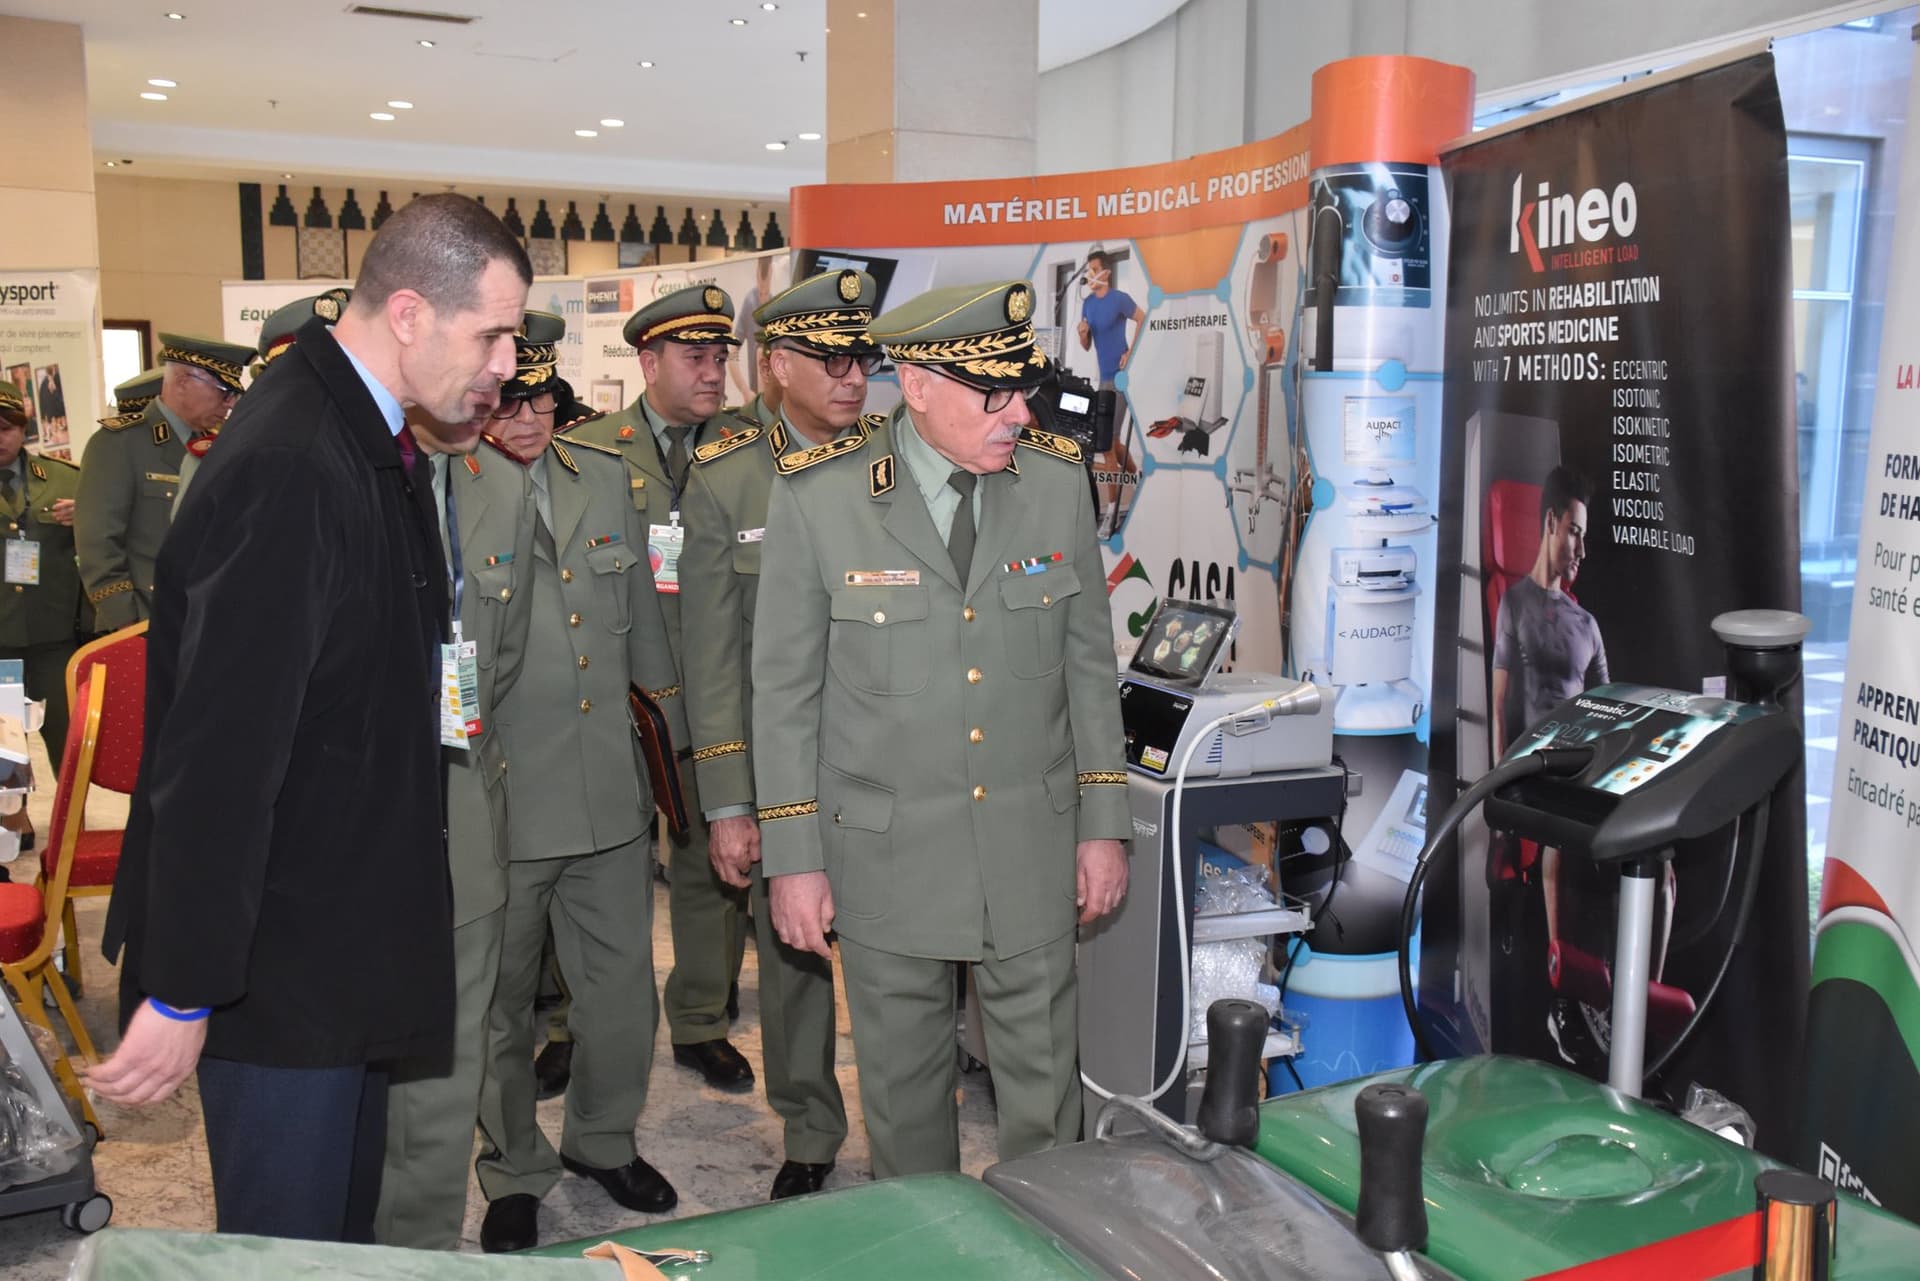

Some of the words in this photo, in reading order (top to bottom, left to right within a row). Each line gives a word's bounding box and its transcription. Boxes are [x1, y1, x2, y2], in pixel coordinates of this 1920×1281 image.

[943, 196, 1087, 225] MATÉRIEL
[1096, 181, 1200, 217] MÉDICAL
[1207, 151, 1310, 201] PROFESSION
[1510, 172, 1638, 273] kineo
[1551, 247, 1615, 271] INTELLIGENT
[1617, 244, 1639, 262] LOAD
[1475, 296, 1492, 318] NO
[1493, 290, 1529, 315] LIMITS
[1532, 288, 1546, 312] IN
[1549, 276, 1661, 310] REHABILITATION
[1474, 326, 1496, 348] AND
[1498, 322, 1546, 347] SPORTS
[1548, 316, 1619, 344] MEDICINE
[1473, 360, 1499, 382] WITH
[1503, 356, 1512, 381] 7
[1518, 352, 1606, 381] METHODS:
[1613, 360, 1668, 380] ECCENTRIC
[1897, 365, 1913, 389] LA
[1613, 388, 1660, 408] ISOTONIC
[1366, 420, 1401, 430] AUDACT
[1613, 416, 1670, 438] ISOKINETIC
[1613, 443, 1670, 466] ISOMETRIC
[1613, 470, 1660, 492] ELASTIC
[1612, 497, 1664, 521] VISCOUS
[1880, 493, 1897, 517] DE
[1612, 525, 1669, 550] VARIABLE
[1671, 533, 1695, 555] LOAD
[1874, 542, 1906, 571] Pour
[1869, 586, 1907, 614] santé
[1350, 624, 1403, 639] AUDACT
[1848, 768, 1905, 816] Encadré
